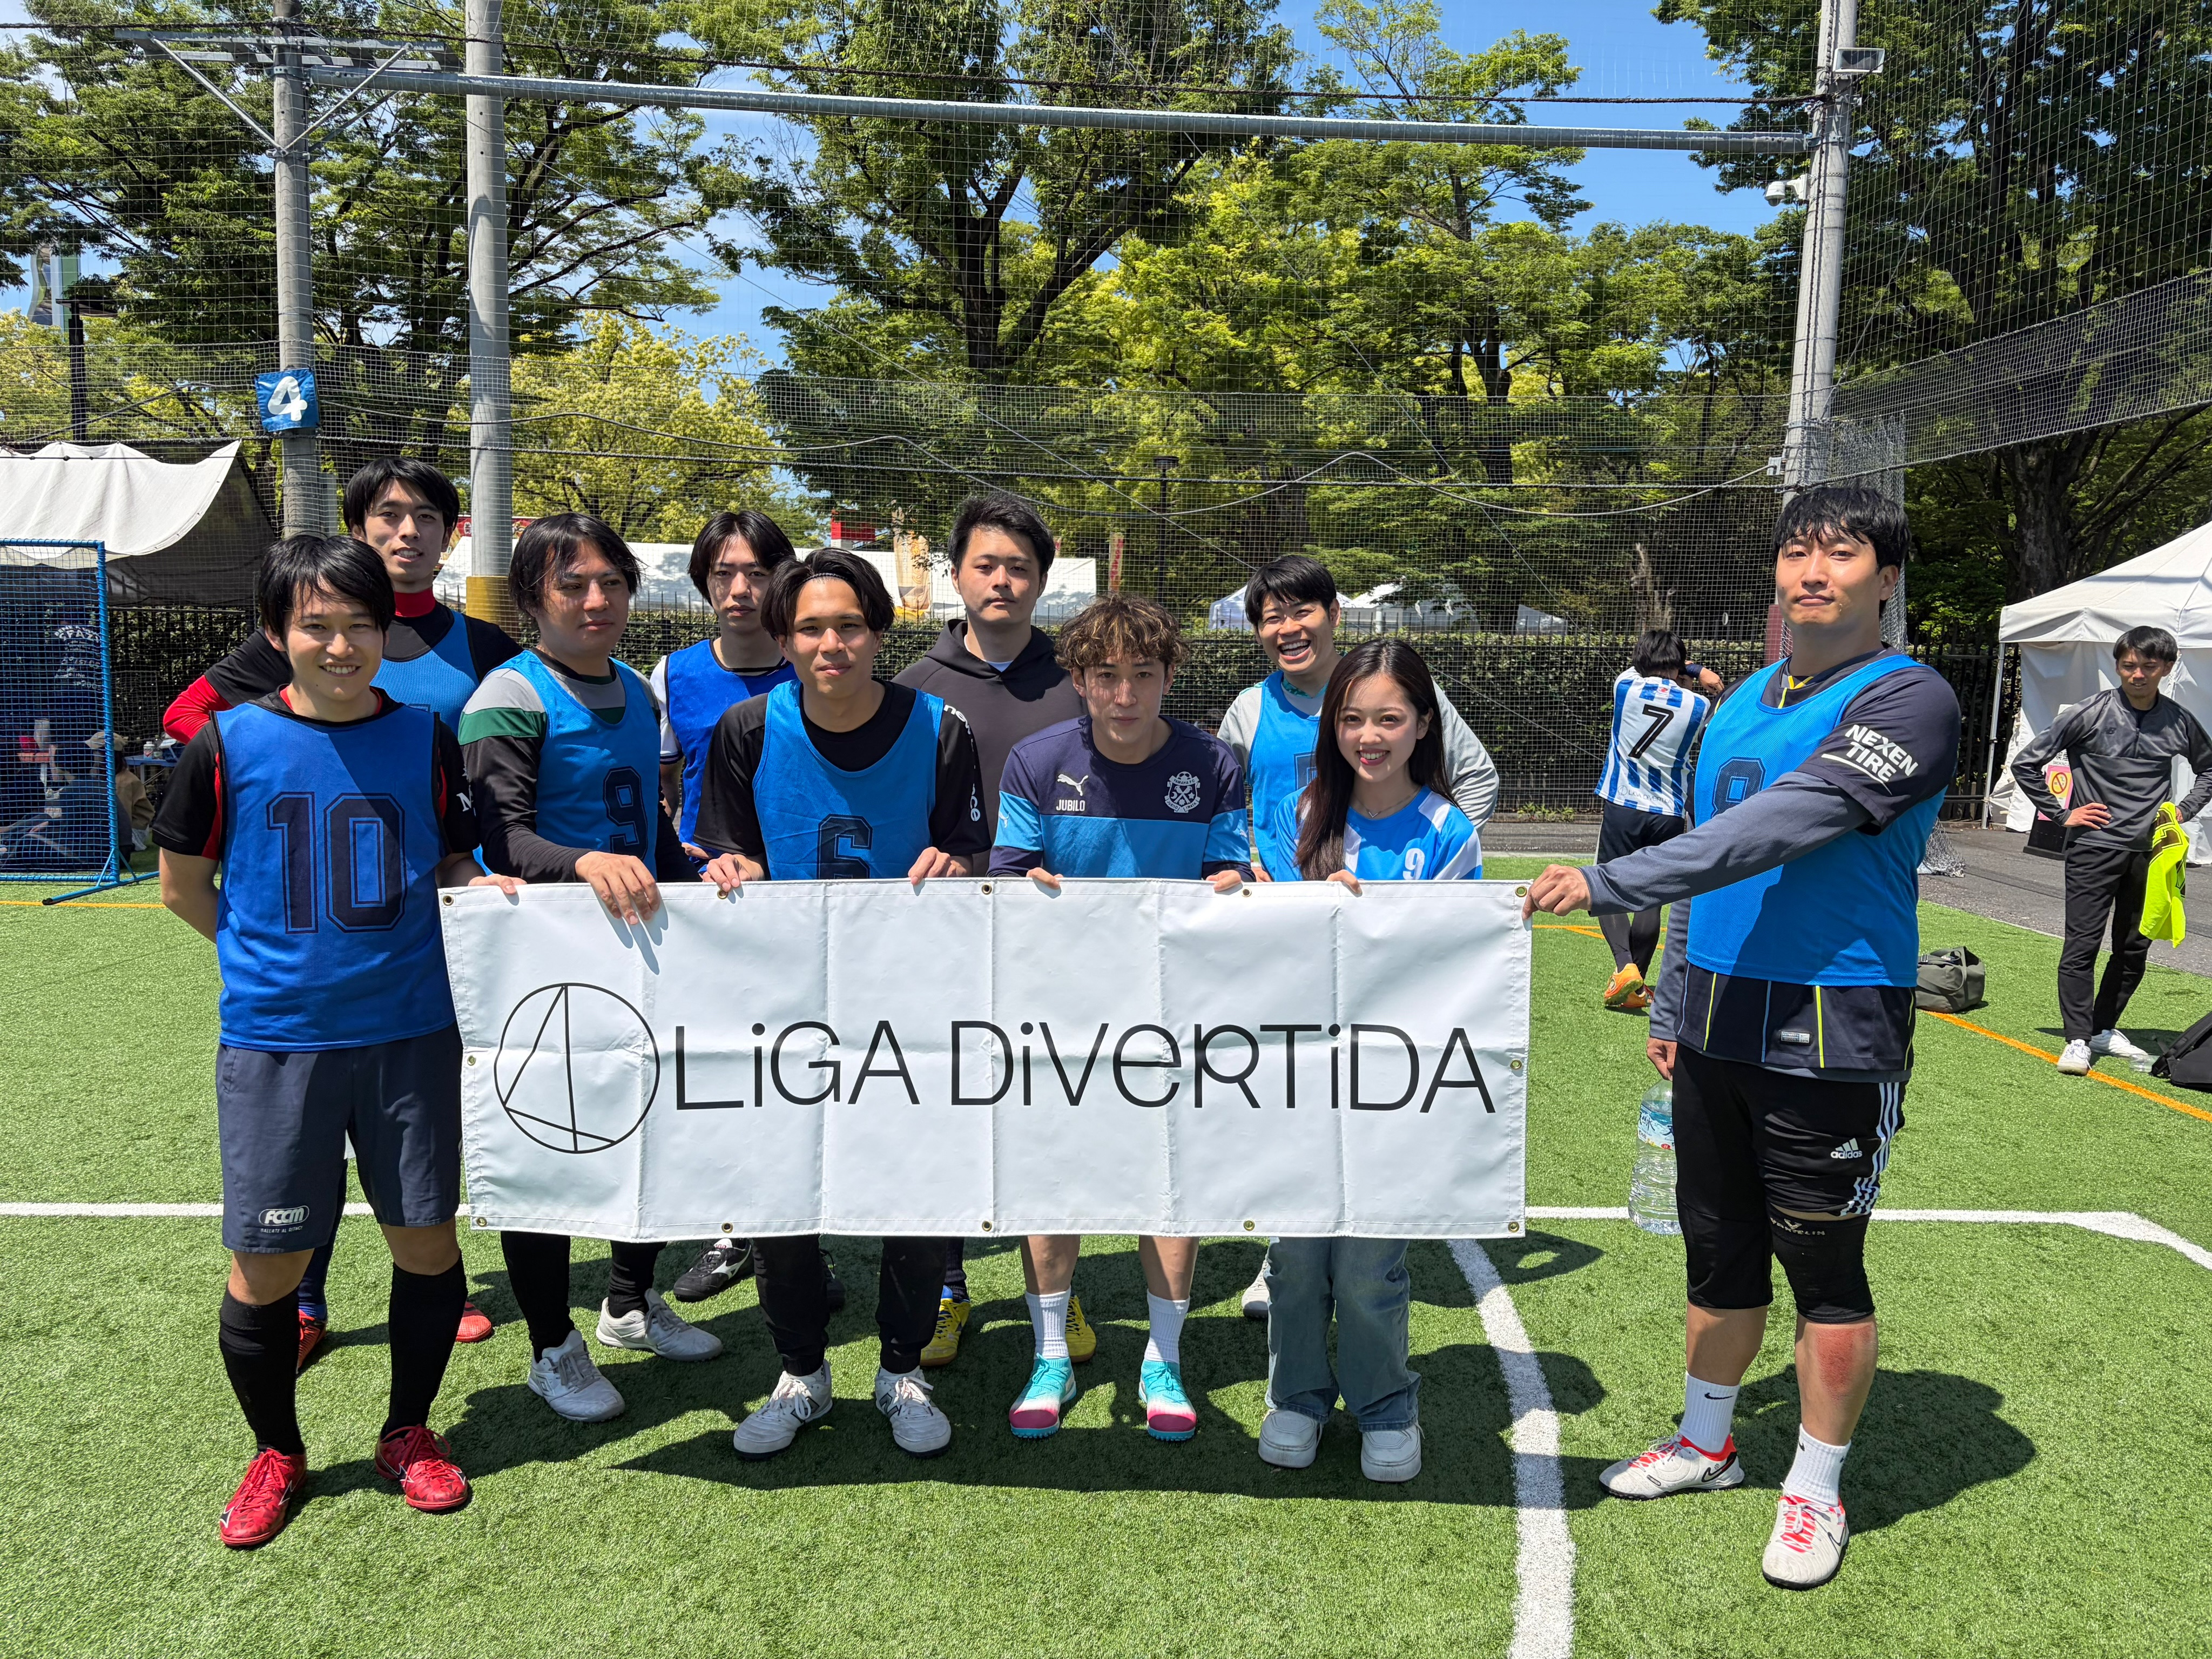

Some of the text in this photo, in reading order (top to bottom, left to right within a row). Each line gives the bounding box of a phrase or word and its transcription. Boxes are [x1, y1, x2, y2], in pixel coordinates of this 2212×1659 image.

[268, 376, 308, 421] 4
[1628, 704, 1674, 759] 7
[1845, 724, 1919, 777] NEXEN
[1846, 741, 1897, 782] TIRE
[603, 766, 648, 862] 9
[1056, 799, 1085, 811] JUBILO
[266, 792, 409, 934] 10
[1402, 848, 1425, 880] 9
[1830, 1150, 1863, 1159] adidas
[264, 1208, 305, 1224] FCCM
